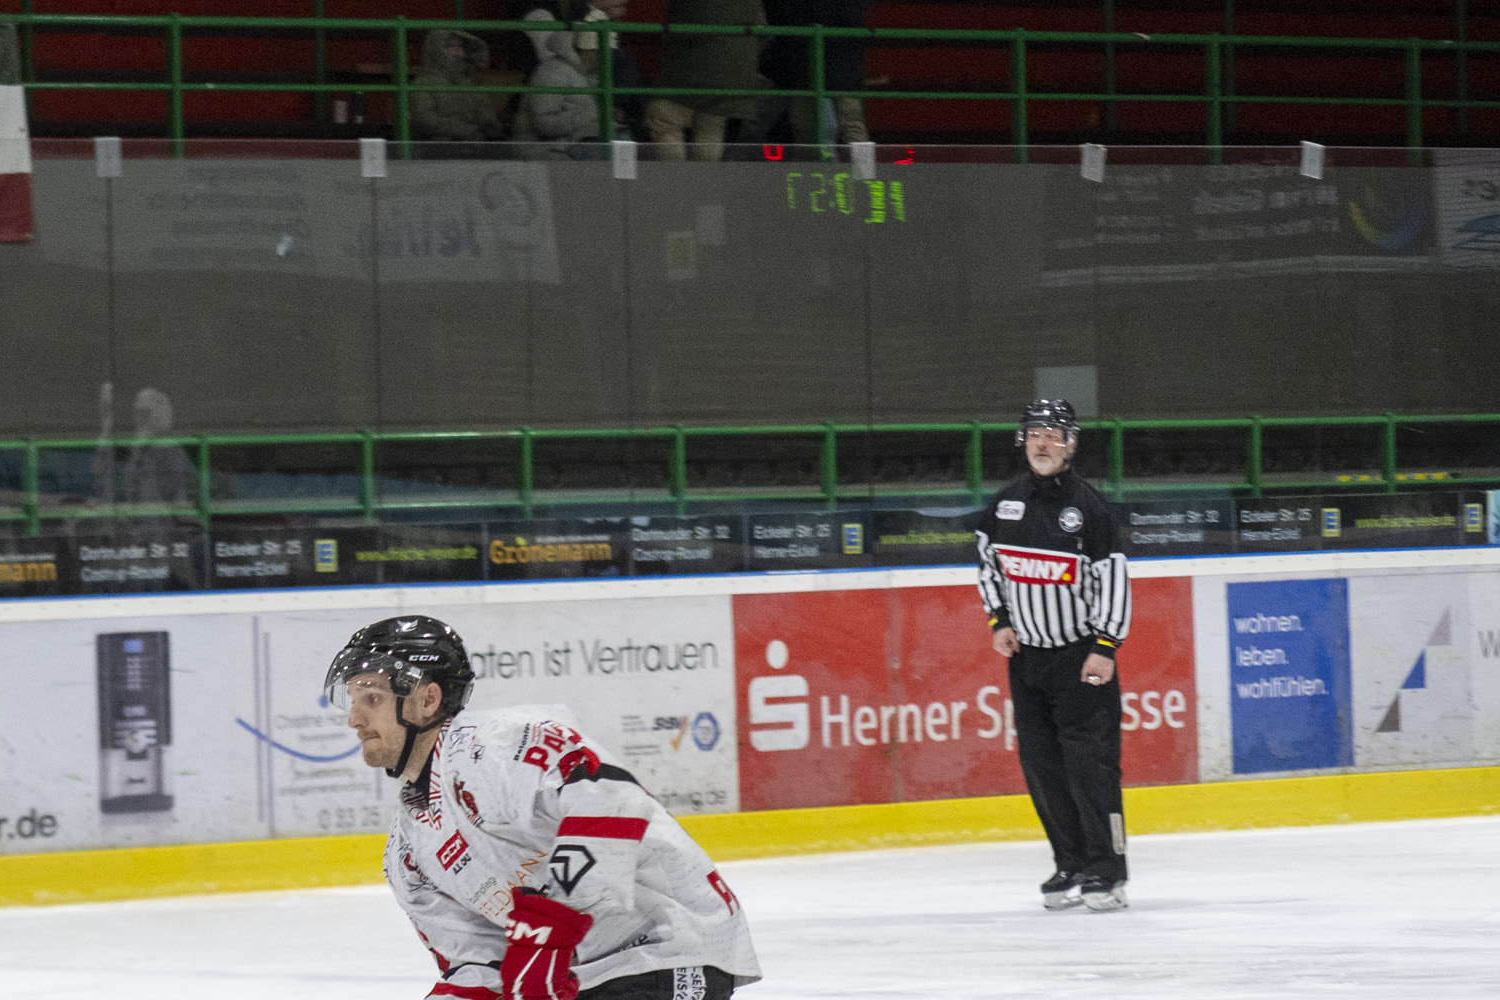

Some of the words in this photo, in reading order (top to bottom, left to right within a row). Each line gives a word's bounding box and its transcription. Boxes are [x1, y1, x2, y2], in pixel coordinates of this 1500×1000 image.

[1234, 613, 1305, 634] wohnen.
[408, 654, 440, 662] CCM
[472, 644, 535, 681] aten
[544, 640, 571, 676] ist
[578, 638, 719, 675] Vertrauen
[1236, 646, 1289, 667] leben.
[1237, 676, 1329, 699] wohlfühlen.
[821, 695, 967, 748] Herner
[977, 686, 1186, 751] Spsse
[504, 918, 553, 945] CM
